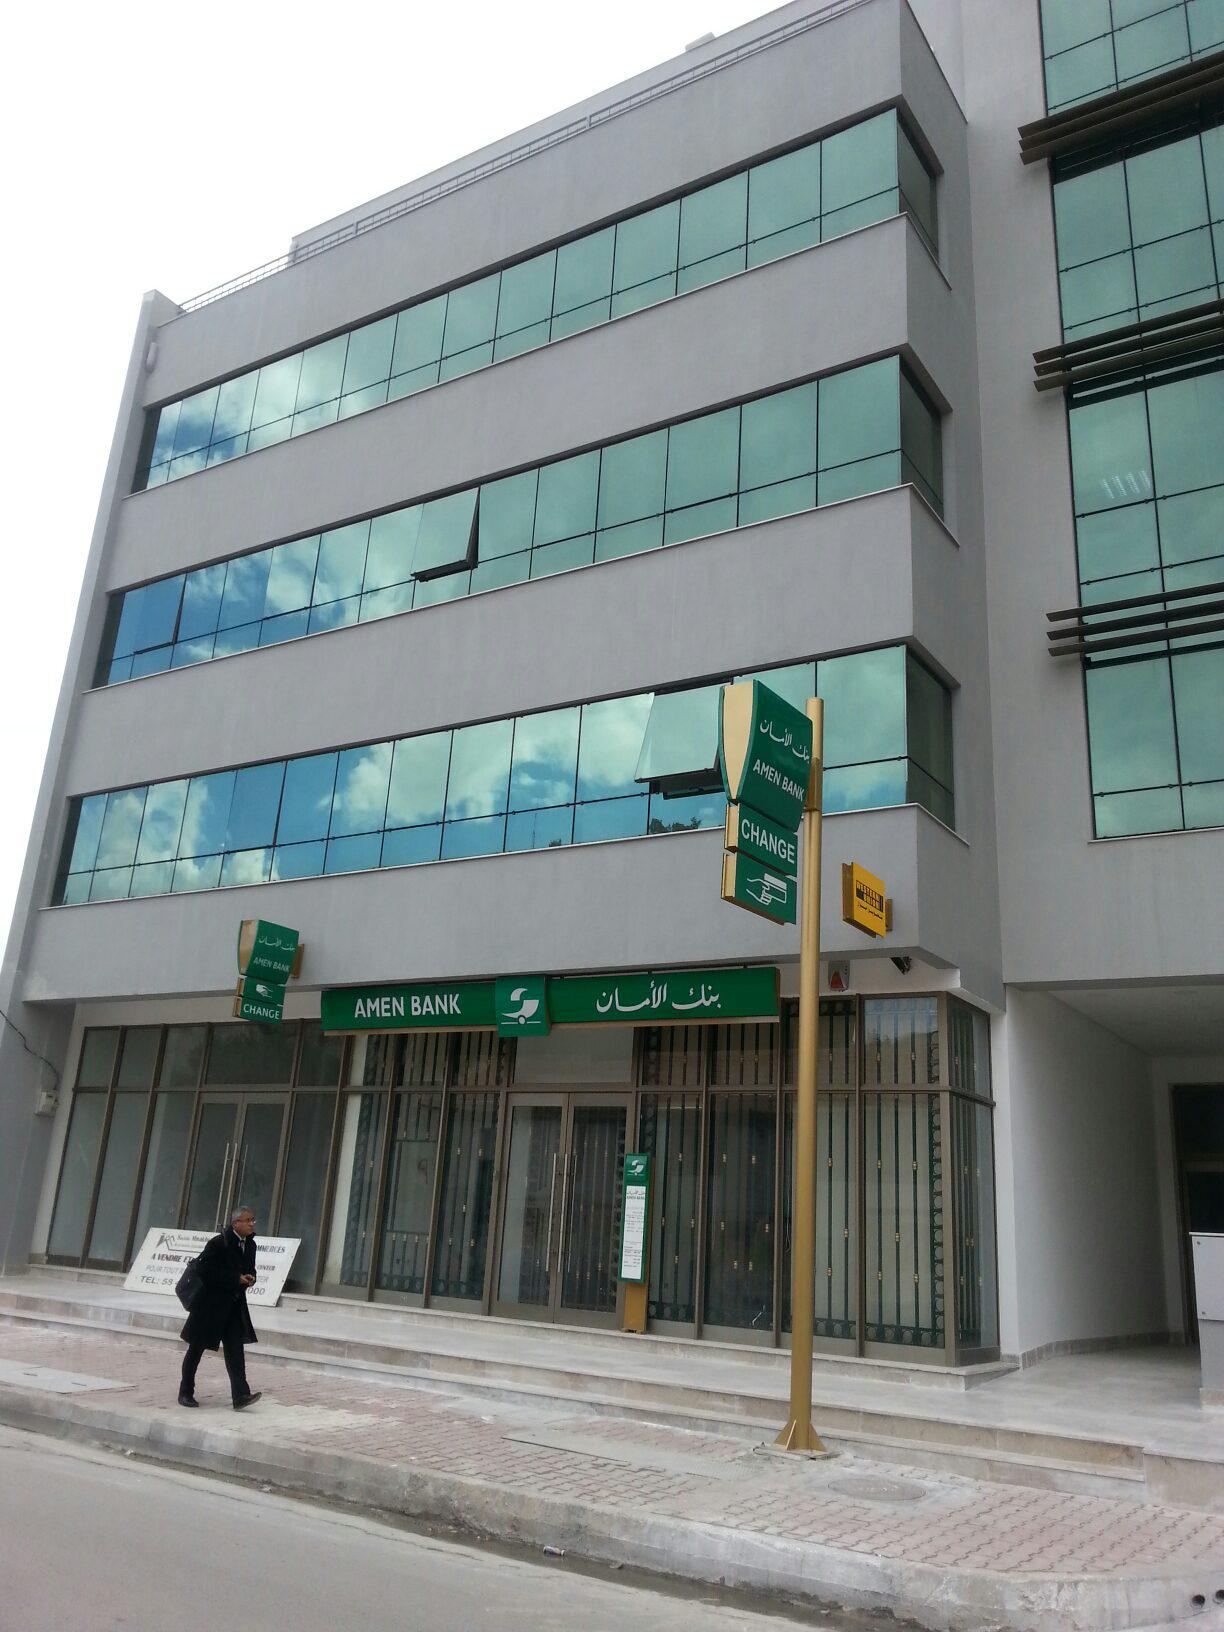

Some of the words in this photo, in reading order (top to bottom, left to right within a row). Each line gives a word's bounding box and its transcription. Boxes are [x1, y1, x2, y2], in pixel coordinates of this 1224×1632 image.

[753, 759, 781, 787] AMEN
[782, 777, 805, 802] BANK
[741, 819, 795, 865] CHANGE
[253, 957, 272, 968] AMEN
[273, 961, 290, 973] BANK
[354, 996, 405, 1018] AMEN
[410, 993, 462, 1016] BANK
[595, 979, 668, 1013] الأمان
[671, 983, 722, 1010] بنك
[243, 1003, 280, 1020] CHANGE
[157, 1253, 183, 1263] VENDRE
